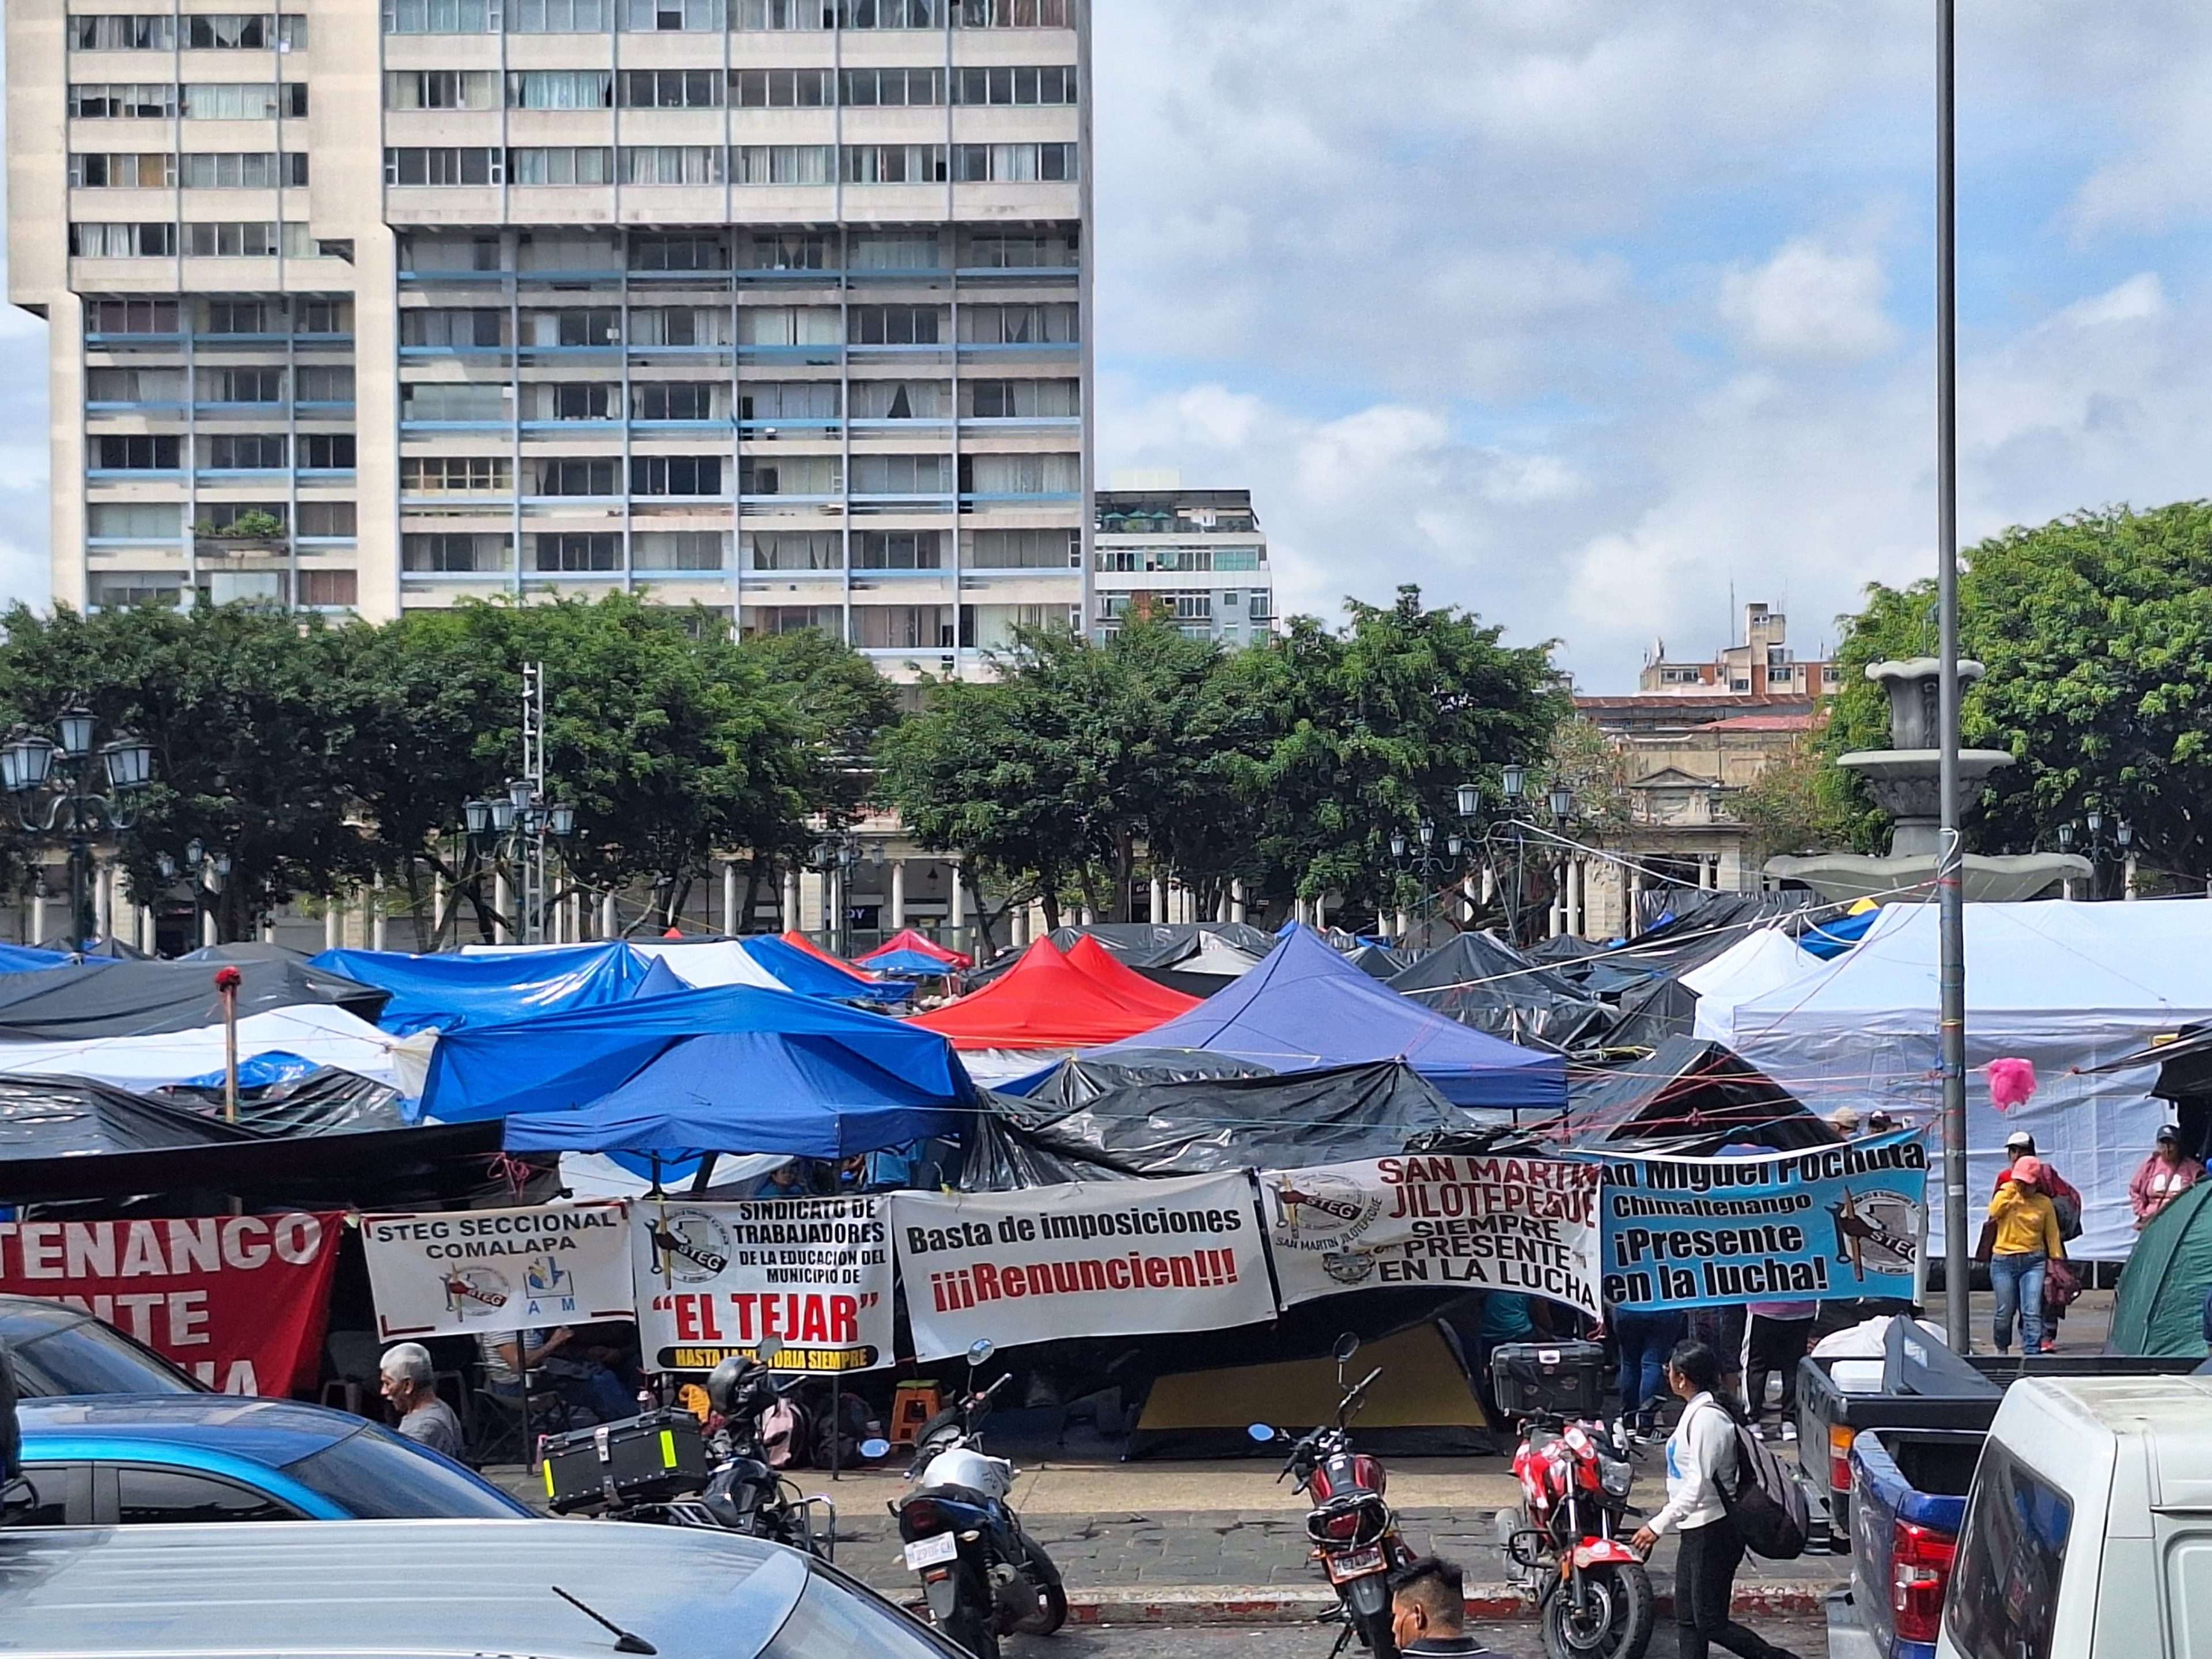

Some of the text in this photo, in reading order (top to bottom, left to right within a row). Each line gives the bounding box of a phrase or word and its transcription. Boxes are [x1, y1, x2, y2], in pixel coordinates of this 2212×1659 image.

[1377, 1156, 1458, 1184] SAN
[1602, 1162, 1638, 1188] an
[740, 1199, 876, 1221] SINDICATO DE
[1306, 1196, 1354, 1217] STEG
[1389, 1183, 1597, 1228] JILOTEPEQUE
[1612, 1193, 1811, 1218] Chimaltenango
[378, 1213, 617, 1242] STEG SECCIONAL
[733, 1222, 885, 1244] TRABAJADORES
[907, 1207, 1241, 1254] Basta de imposiciones
[1411, 1215, 1561, 1243] SIEMPRE
[426, 1236, 577, 1259] COMALAPA
[678, 1244, 721, 1270] STEG
[740, 1251, 756, 1265] DE
[760, 1251, 777, 1265] LA
[862, 1249, 886, 1265] DEL
[1404, 1236, 1570, 1271] PRESENTE
[1616, 1225, 1803, 1266] ¡Presente
[767, 1268, 860, 1284] MUNICIPIO DE
[1380, 1259, 1596, 1310] EN LA LUCHA
[1604, 1256, 1828, 1304] en la lucha!
[675, 1349, 720, 1367] HASTA
[808, 1349, 868, 1369] SIEMPRE
